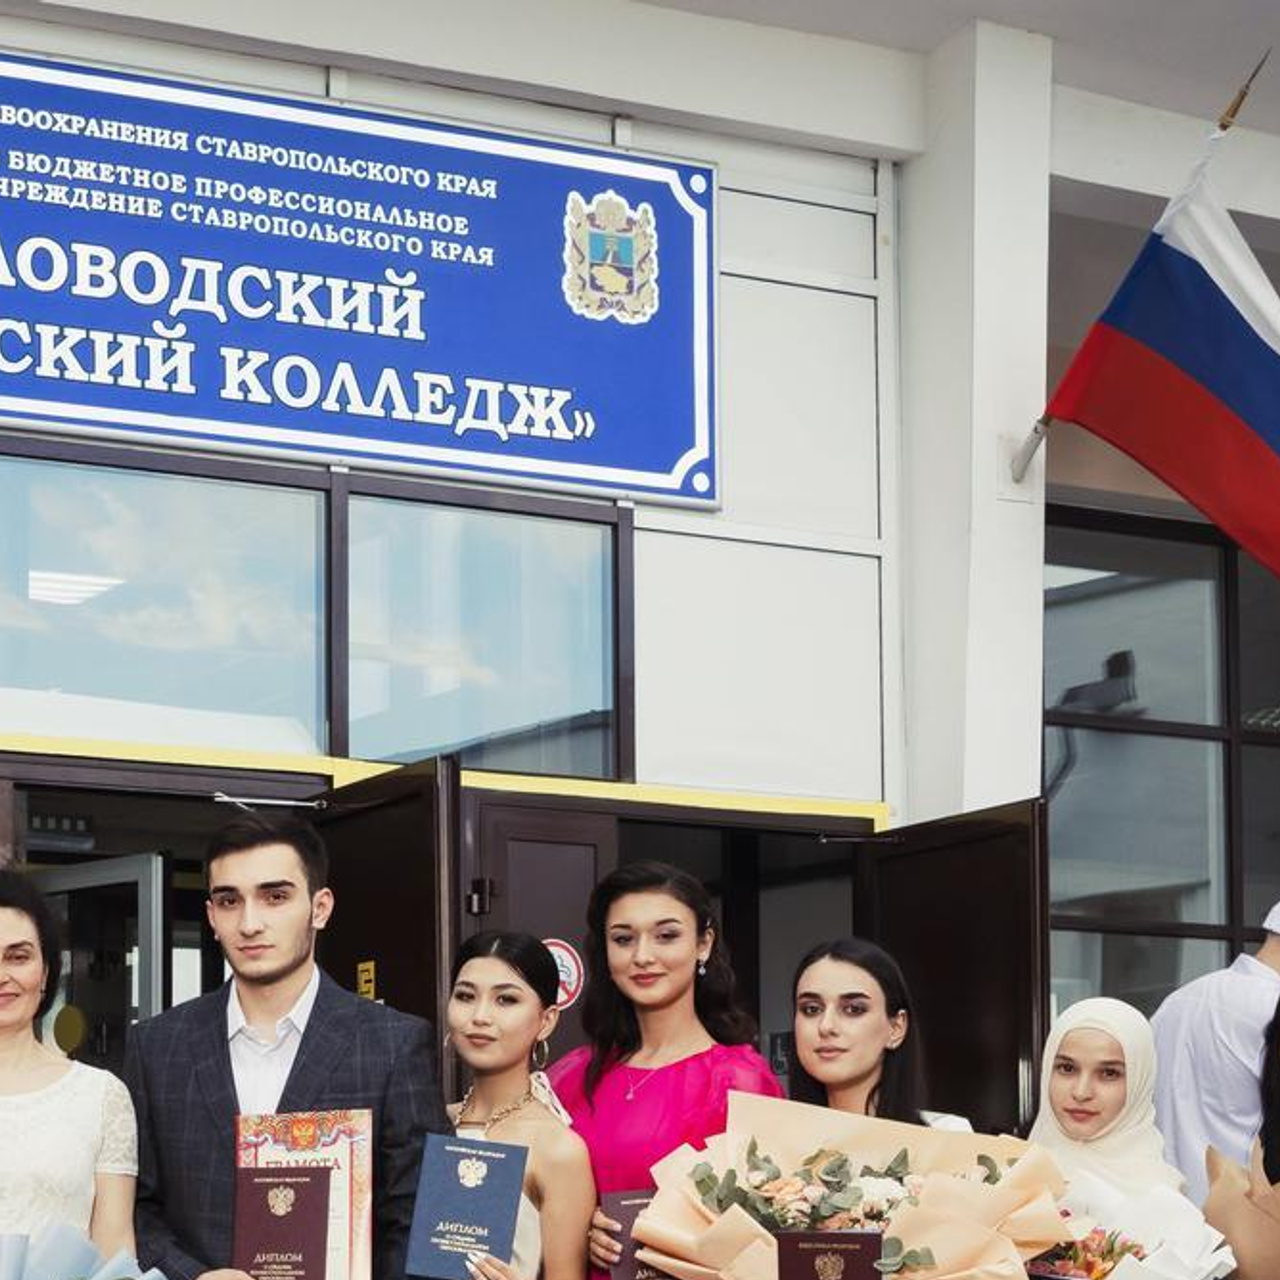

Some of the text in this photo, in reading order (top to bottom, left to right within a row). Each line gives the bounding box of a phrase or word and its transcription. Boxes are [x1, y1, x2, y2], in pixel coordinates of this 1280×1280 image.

[8, 150, 187, 193] БЮДЖЕТНОЕ
[195, 177, 469, 235] ПРОФЕССИОНАЛЬНОЕ
[195, 135, 430, 188] СТАВРОПОЛЬСКОГО
[436, 171, 497, 199] КРАЯ
[171, 202, 422, 256] СТАВРОПОЛЬСКОГО
[430, 240, 494, 266] КРАЯ
[220, 346, 595, 441] КОЛЛЕДЖ»
[253, 1252, 303, 1264] ДИПЛОМ
[435, 1221, 489, 1236] ДИПЛОМ
